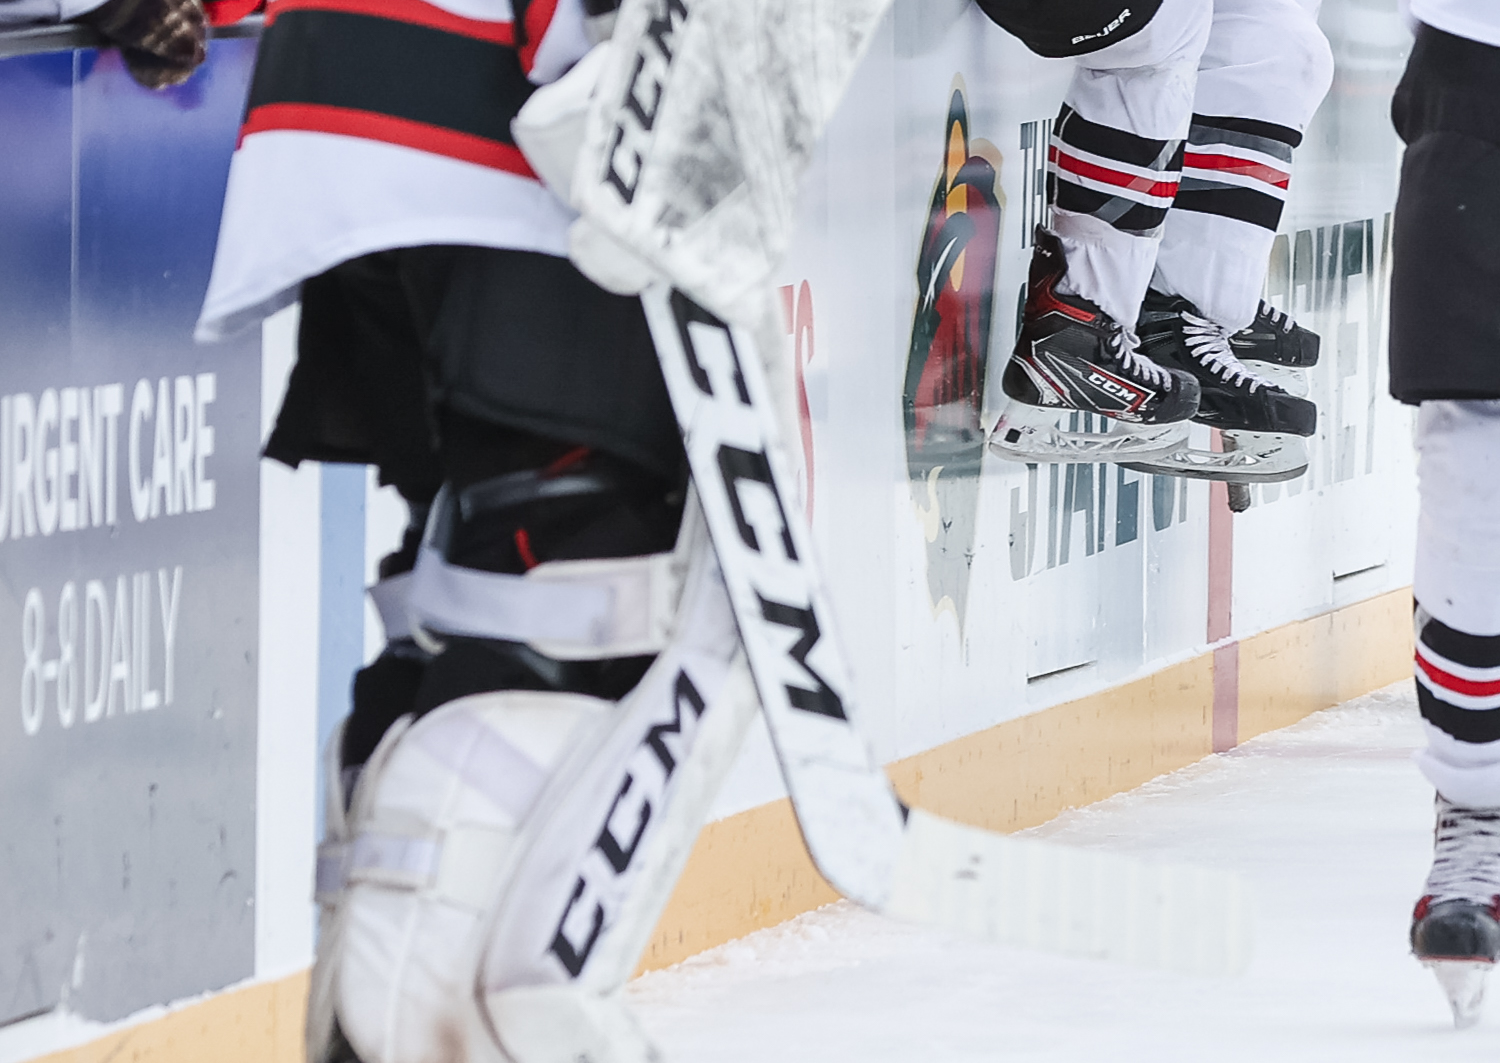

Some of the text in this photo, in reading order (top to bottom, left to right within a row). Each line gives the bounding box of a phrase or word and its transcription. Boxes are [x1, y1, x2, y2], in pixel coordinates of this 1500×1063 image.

[129, 371, 216, 515] CARE
[1087, 372, 1138, 402] CCM
[670, 287, 850, 723] CCM
[21, 564, 184, 736] 8-8 DAILY
[548, 667, 707, 979] CCM
